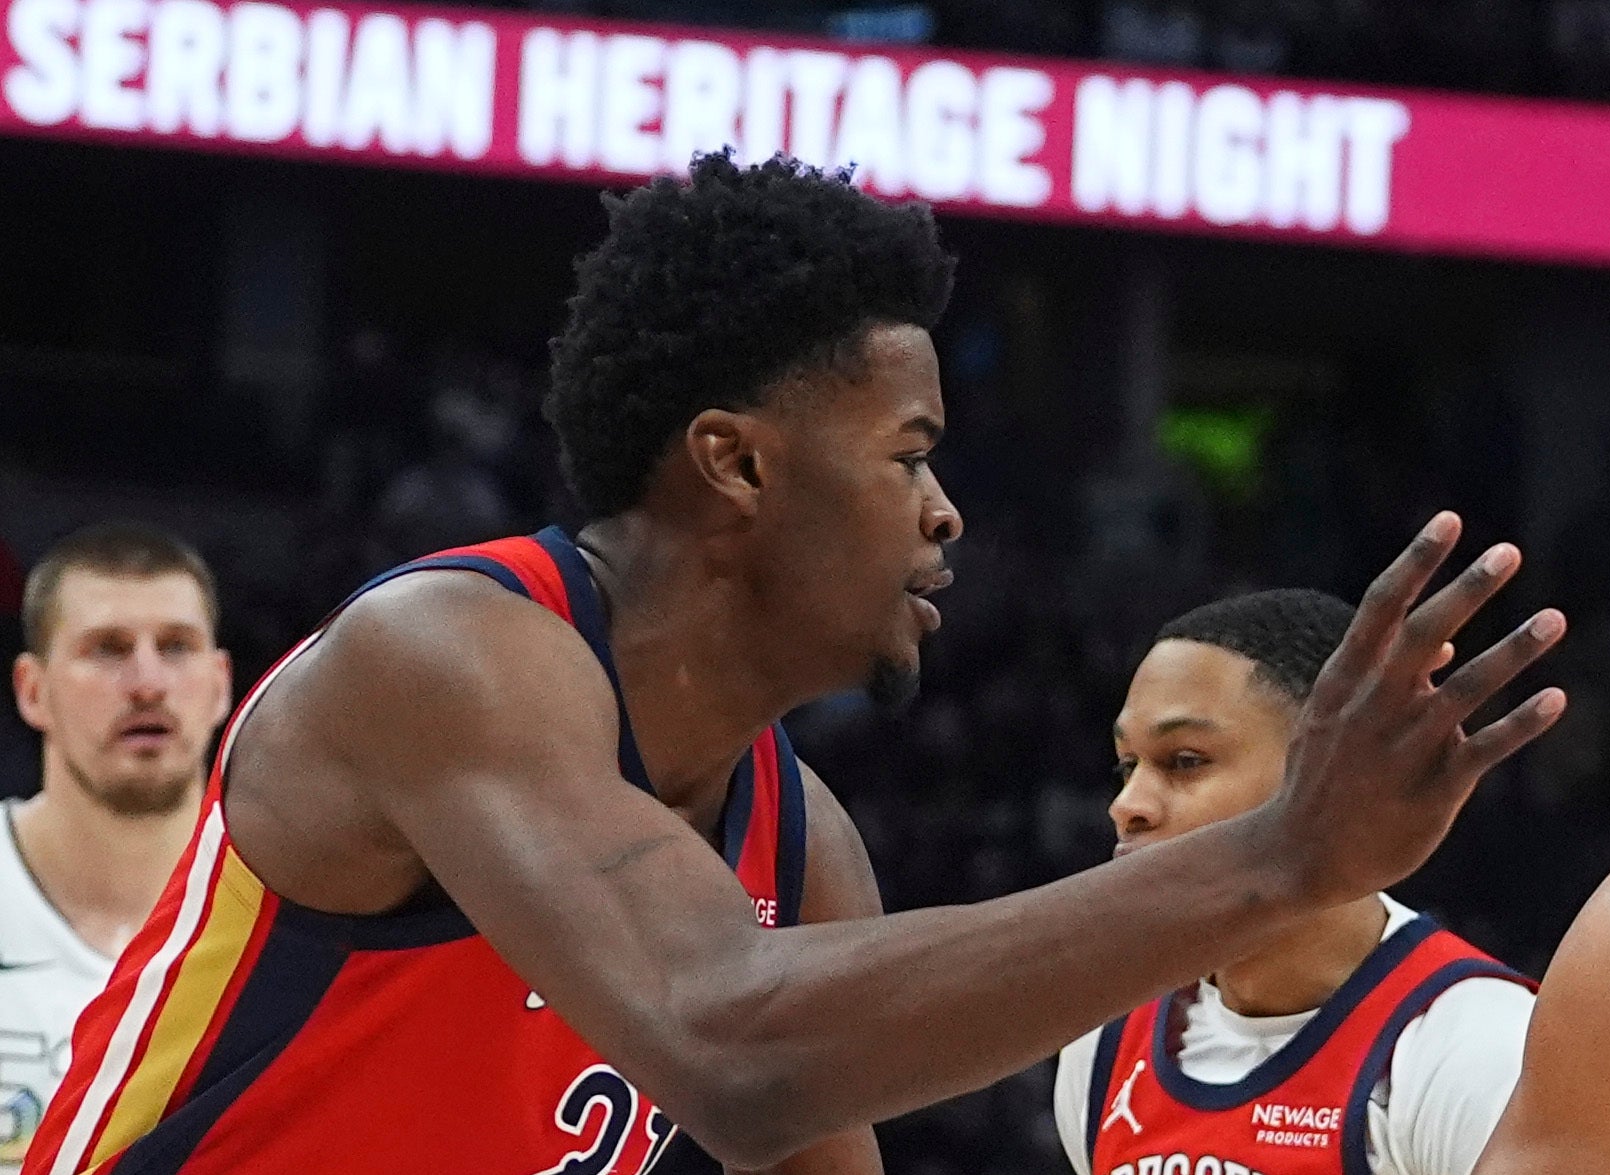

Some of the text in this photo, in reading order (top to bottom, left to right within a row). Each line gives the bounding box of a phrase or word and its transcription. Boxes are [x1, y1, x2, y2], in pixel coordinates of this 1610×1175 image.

[3, 0, 1411, 236] SERBIAN HERITAGE NIGHT
[1251, 1103, 1342, 1130] NEWAGE
[1256, 1130, 1329, 1148] PRODUCTS
